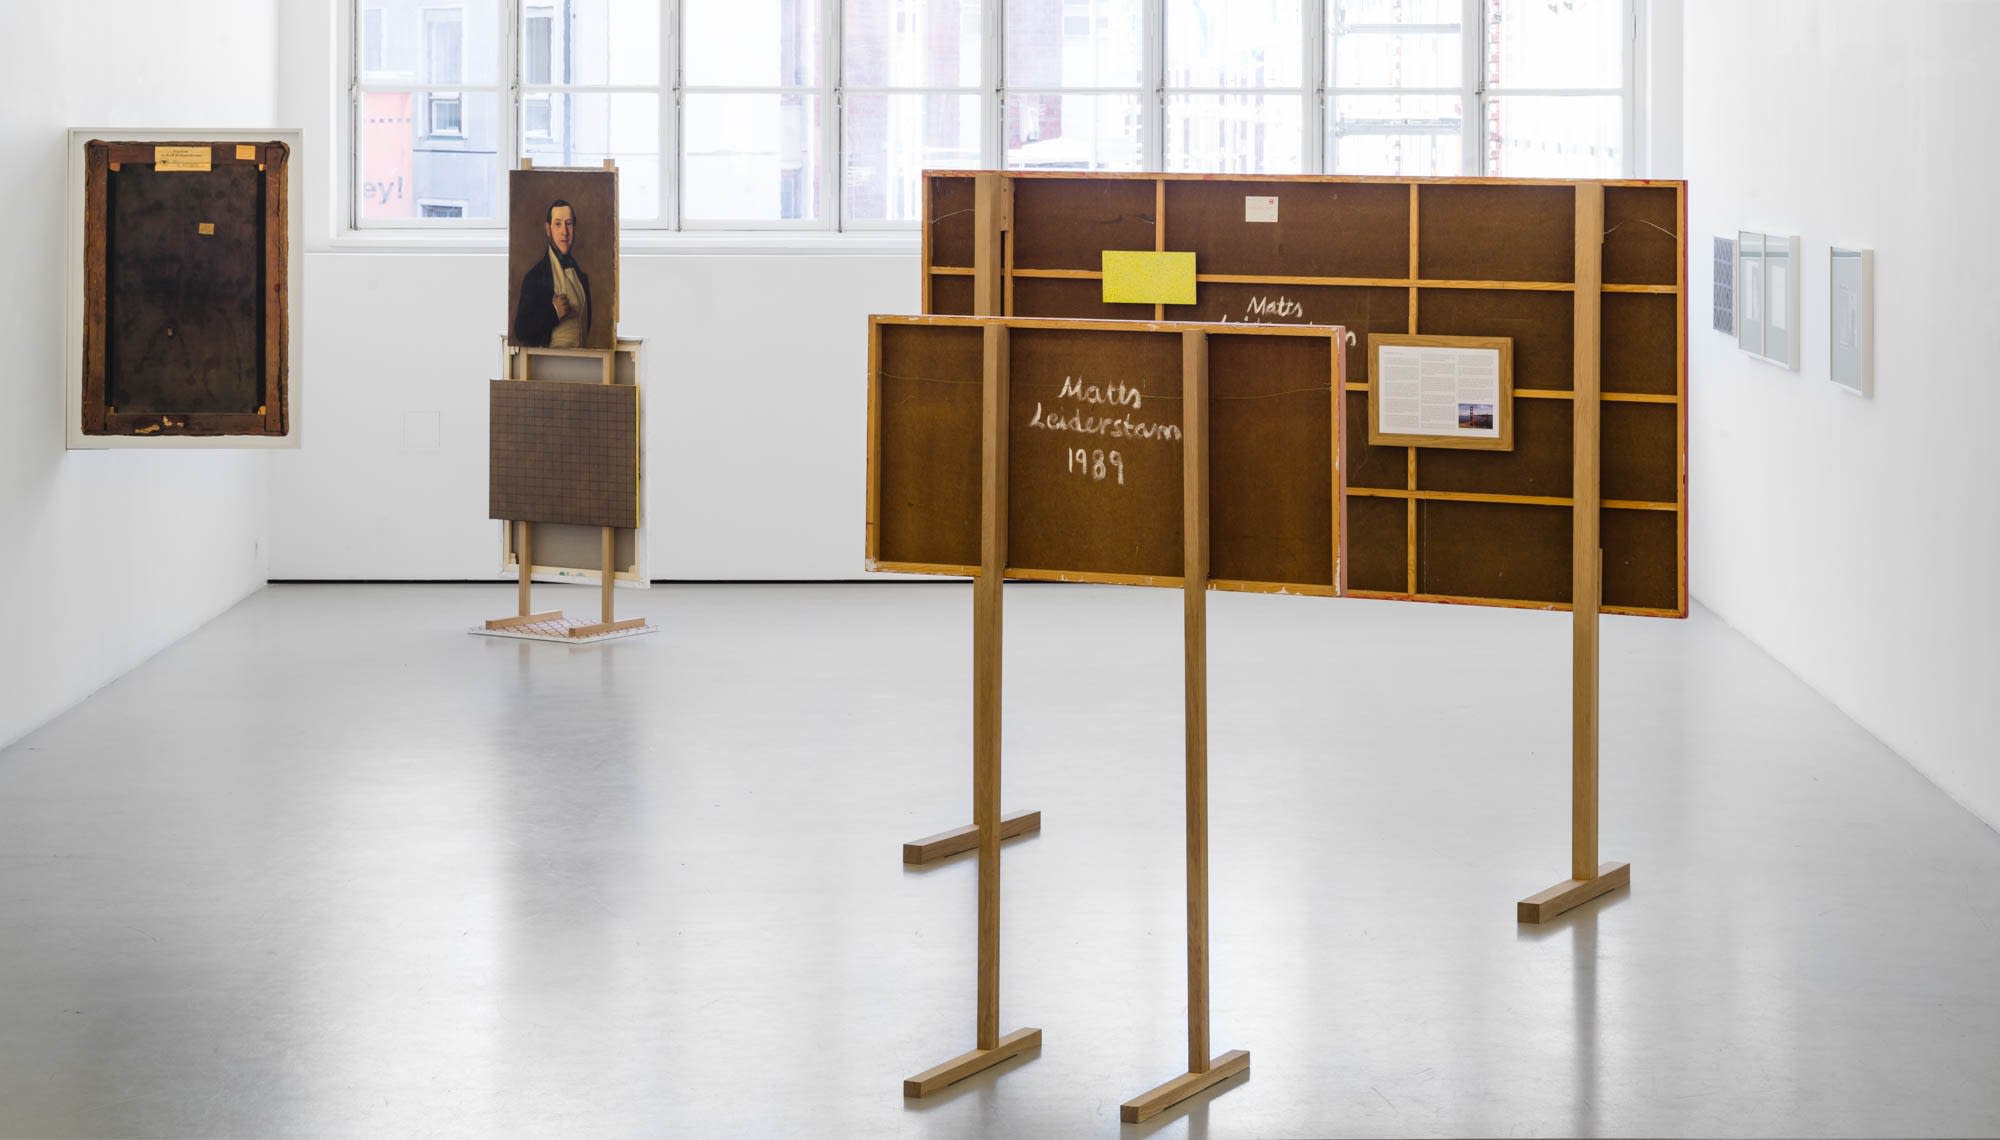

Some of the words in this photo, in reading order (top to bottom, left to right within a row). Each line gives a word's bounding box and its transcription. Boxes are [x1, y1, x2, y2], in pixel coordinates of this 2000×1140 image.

[1247, 295, 1303, 318] Matts
[1058, 375, 1142, 409] Matts
[1029, 401, 1182, 441] Leiderstam
[1069, 447, 1124, 485] 1989
